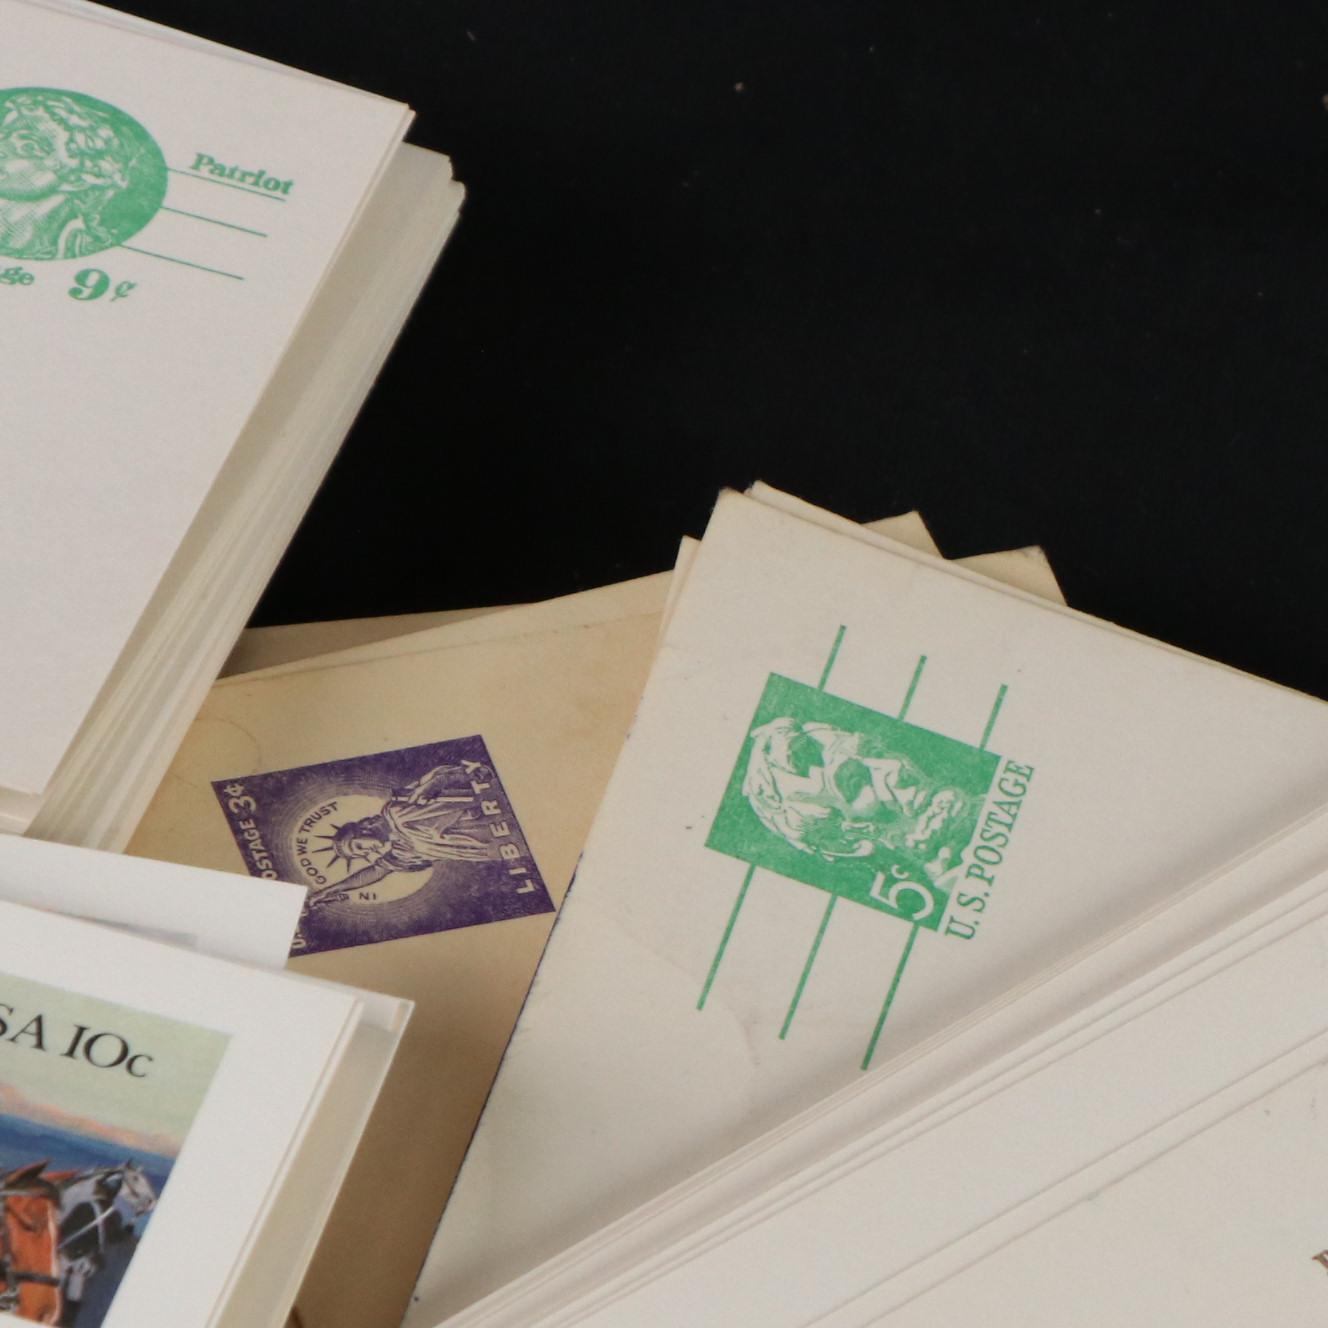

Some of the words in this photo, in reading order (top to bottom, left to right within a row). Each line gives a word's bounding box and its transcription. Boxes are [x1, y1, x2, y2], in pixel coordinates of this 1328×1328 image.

[189, 152, 295, 195] Patriot
[299, 801, 338, 833] TRUST
[461, 759, 536, 894] LIBERTY
[965, 760, 1035, 887] POSTAGE
[238, 818, 278, 881] OSTAGE
[296, 837, 308, 856] WE
[300, 858, 327, 885] GOD
[945, 891, 990, 940] U.S.
[0, 1003, 46, 1052] SA
